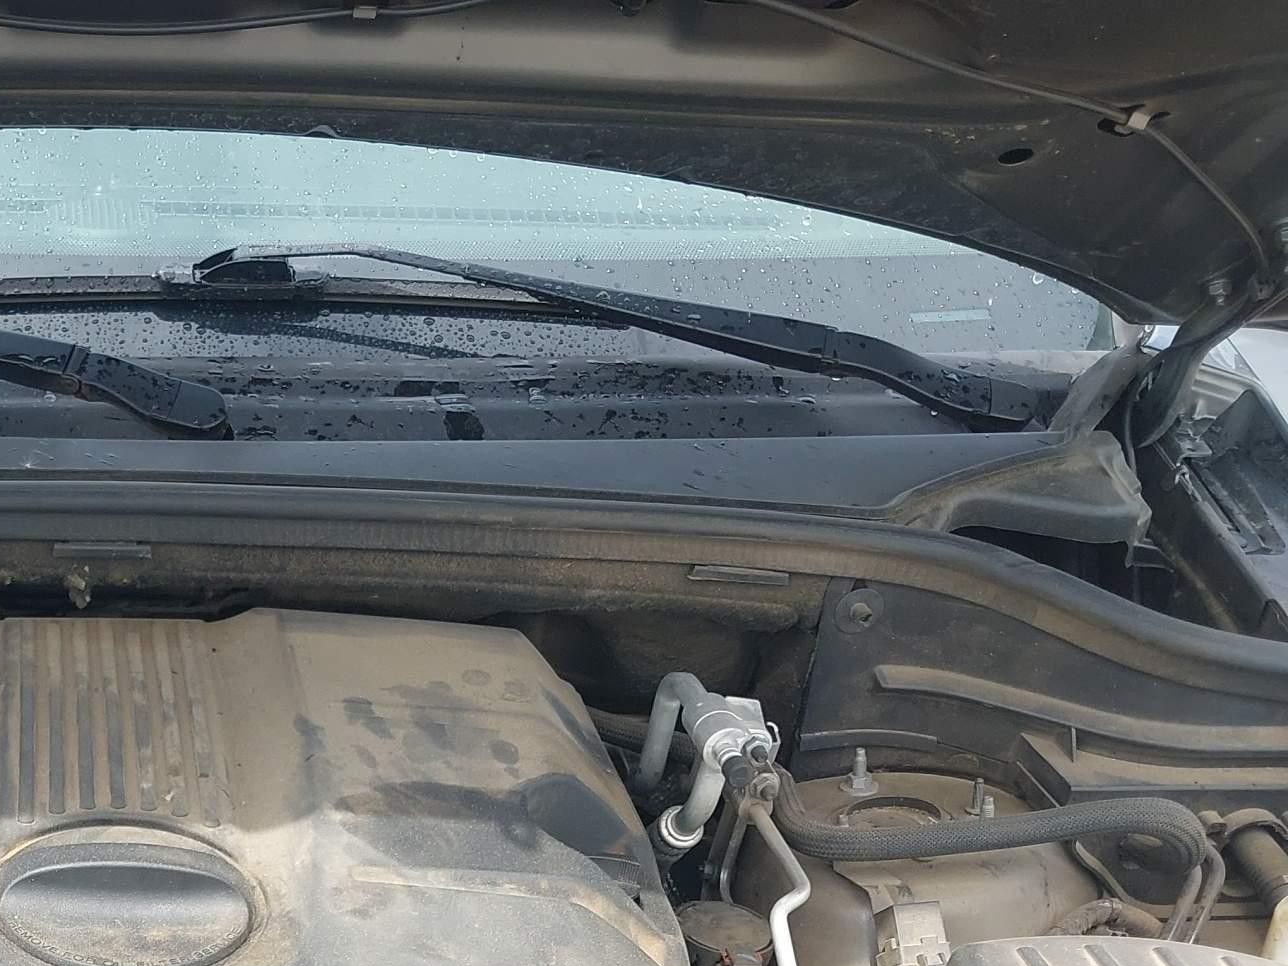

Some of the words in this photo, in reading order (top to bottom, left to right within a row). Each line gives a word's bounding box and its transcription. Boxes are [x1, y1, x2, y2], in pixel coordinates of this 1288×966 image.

[8, 921, 58, 954] REMOVE
[62, 951, 98, 966] FOR
[193, 926, 244, 960] SERVICE
